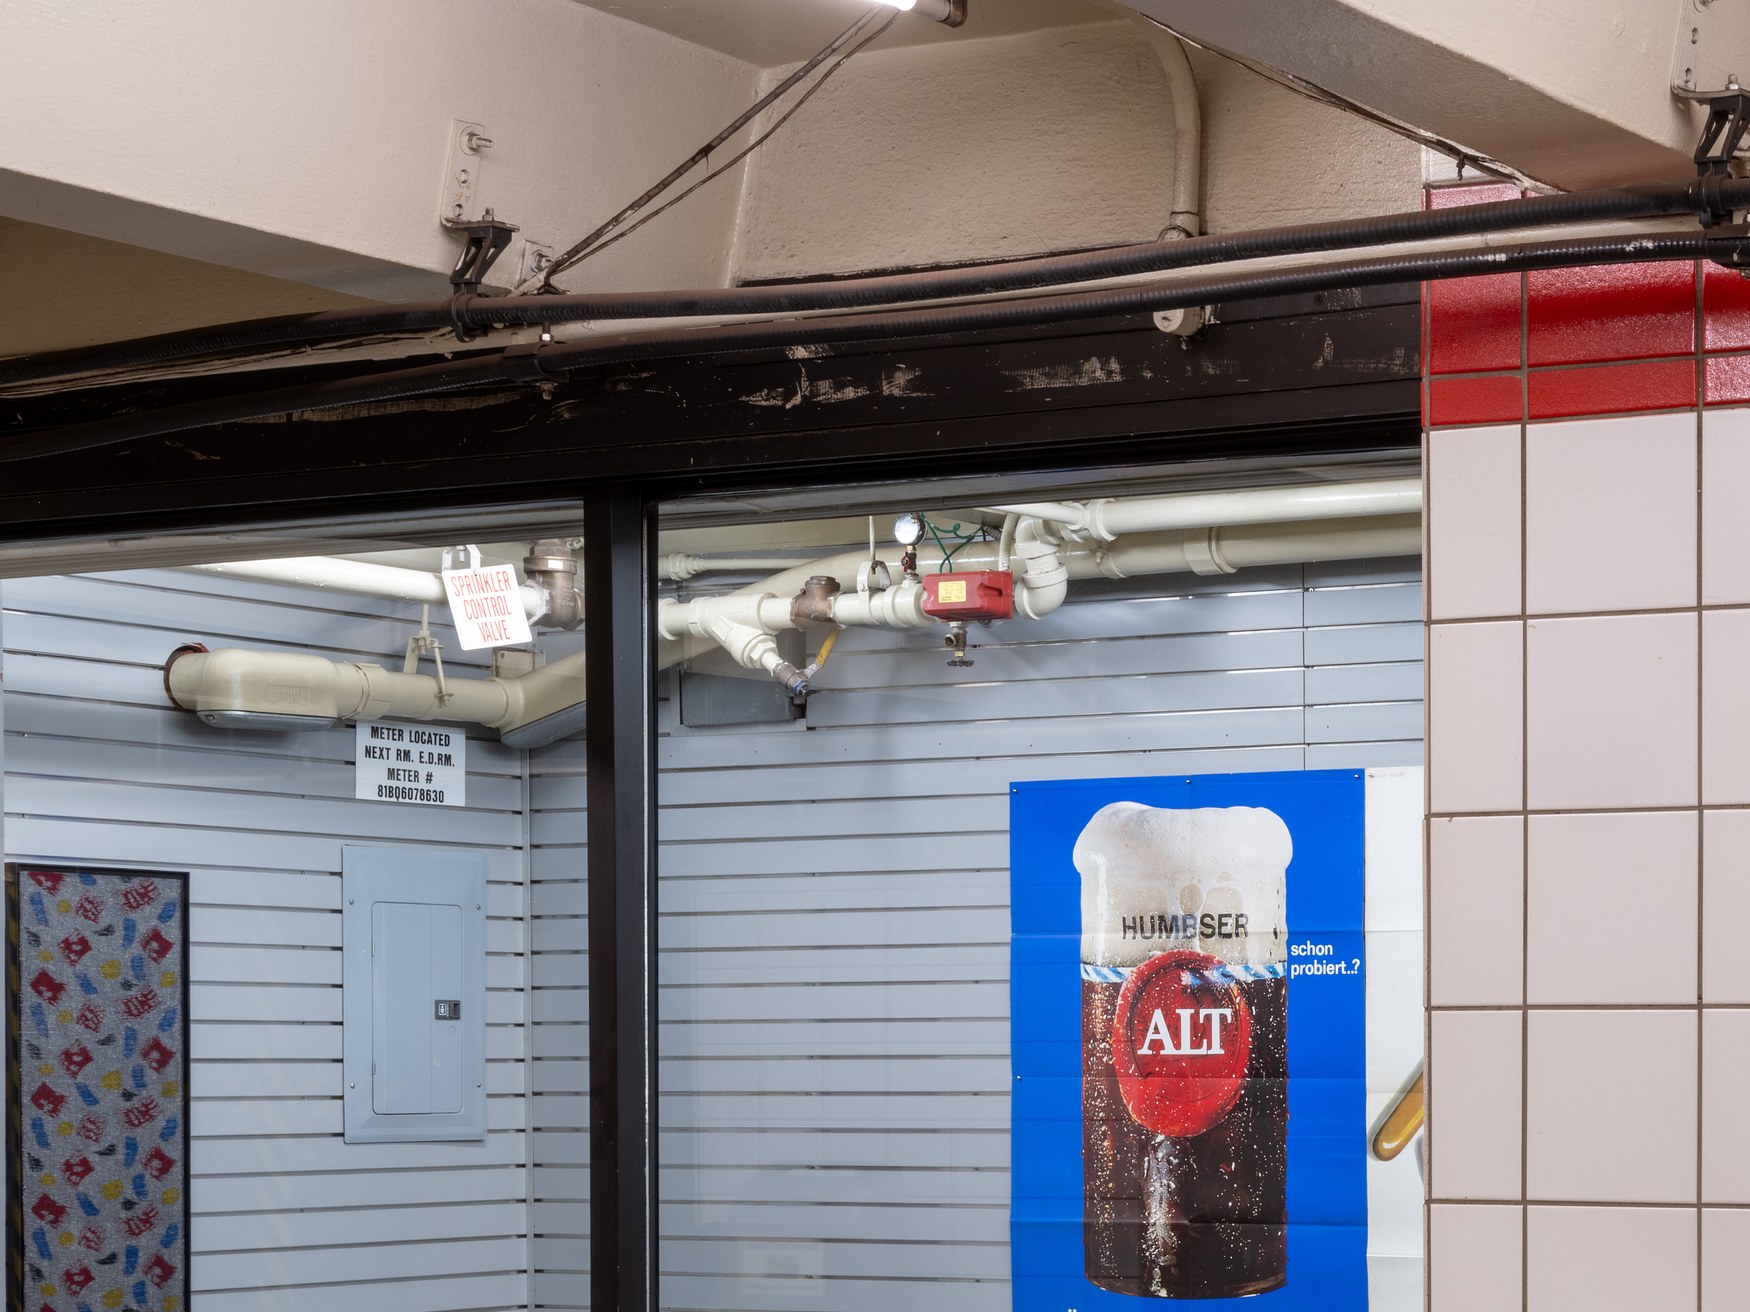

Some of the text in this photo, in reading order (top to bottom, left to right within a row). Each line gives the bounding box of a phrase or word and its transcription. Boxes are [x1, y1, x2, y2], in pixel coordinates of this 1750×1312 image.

[450, 570, 512, 597] SPRINKLER
[463, 595, 512, 620] CONTROL
[477, 619, 511, 642] VALVE
[370, 725, 450, 747] METER LOCATED
[364, 745, 455, 767] NEXT RM. E.D.RM.
[387, 767, 434, 784] METER #
[377, 784, 445, 803] 81BQ6078630
[1122, 913, 1249, 940] HUMBSER
[1290, 940, 1333, 956] schon
[1290, 959, 1360, 979] probiert..?
[1137, 1007, 1232, 1055] ALT
